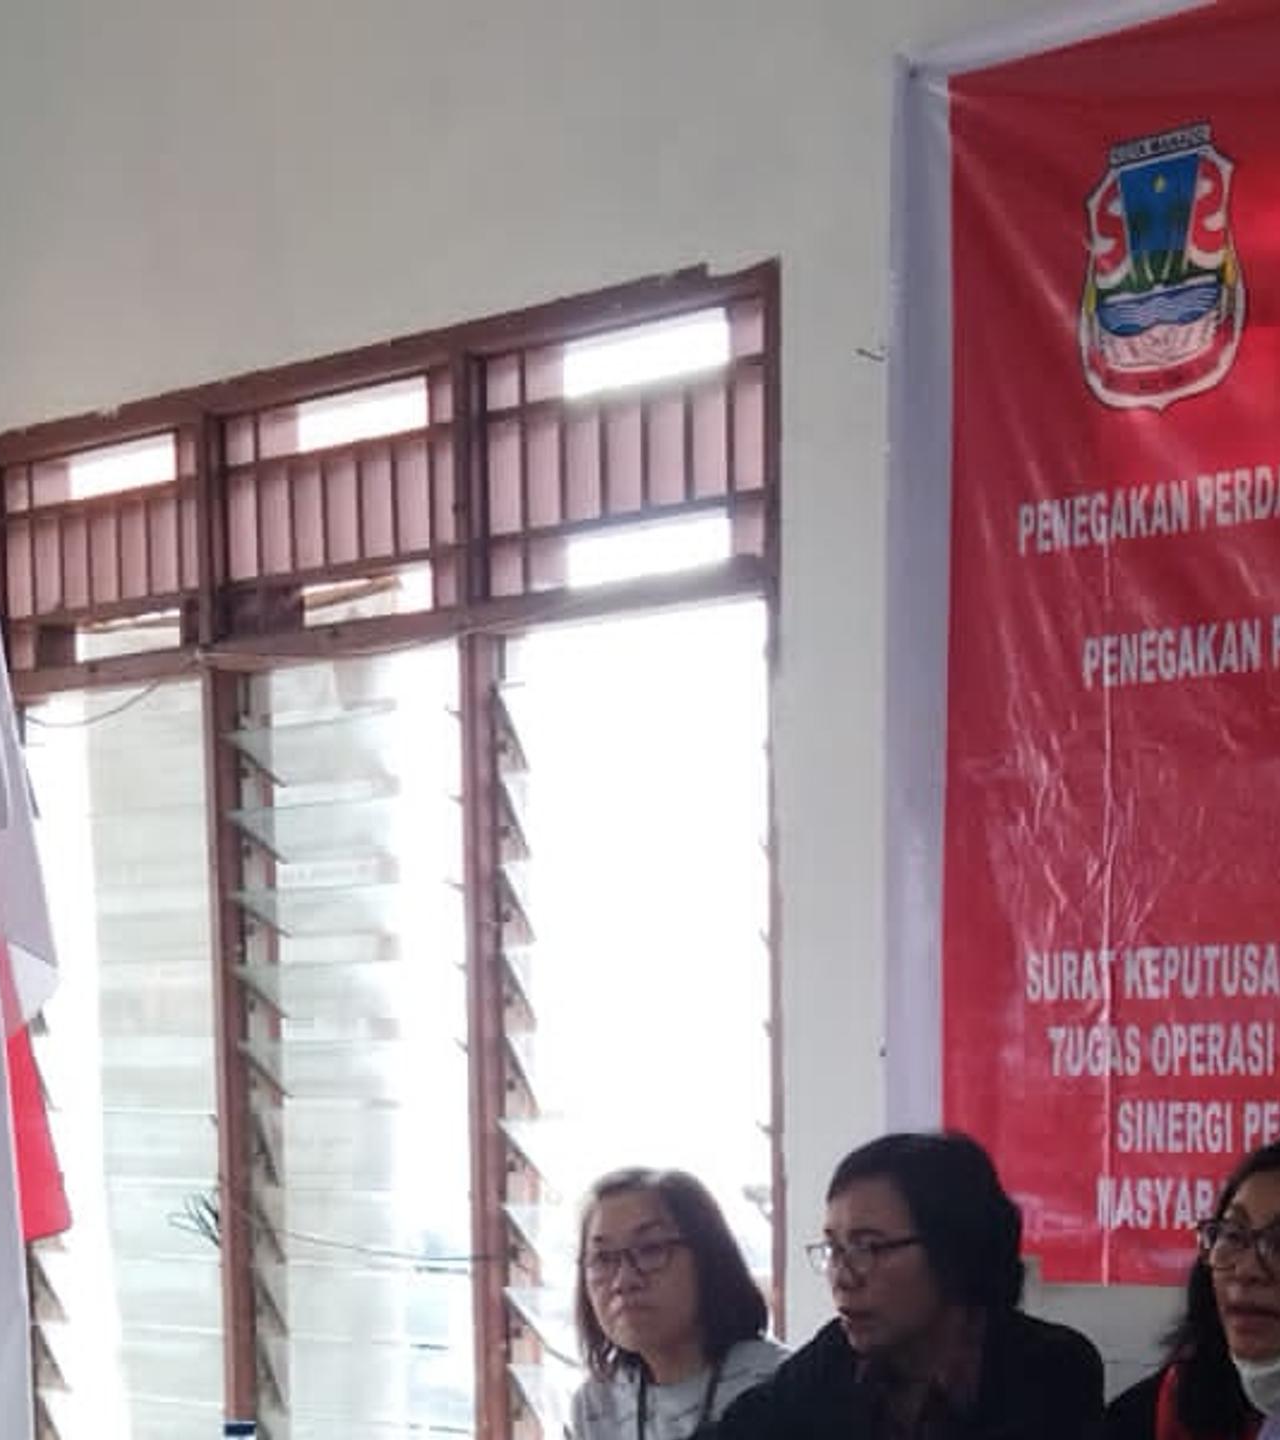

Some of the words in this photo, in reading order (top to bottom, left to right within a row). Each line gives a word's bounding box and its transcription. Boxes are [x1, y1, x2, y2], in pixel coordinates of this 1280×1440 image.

[1017, 478, 1190, 557] PENEGAKAN
[1082, 617, 1260, 690] PENEGAKAN
[1024, 948, 1116, 1001] SURAT
[1048, 1025, 1141, 1077] TUGAS
[1150, 1021, 1275, 1076] OPERASI
[1117, 1101, 1233, 1154] SINERGI
